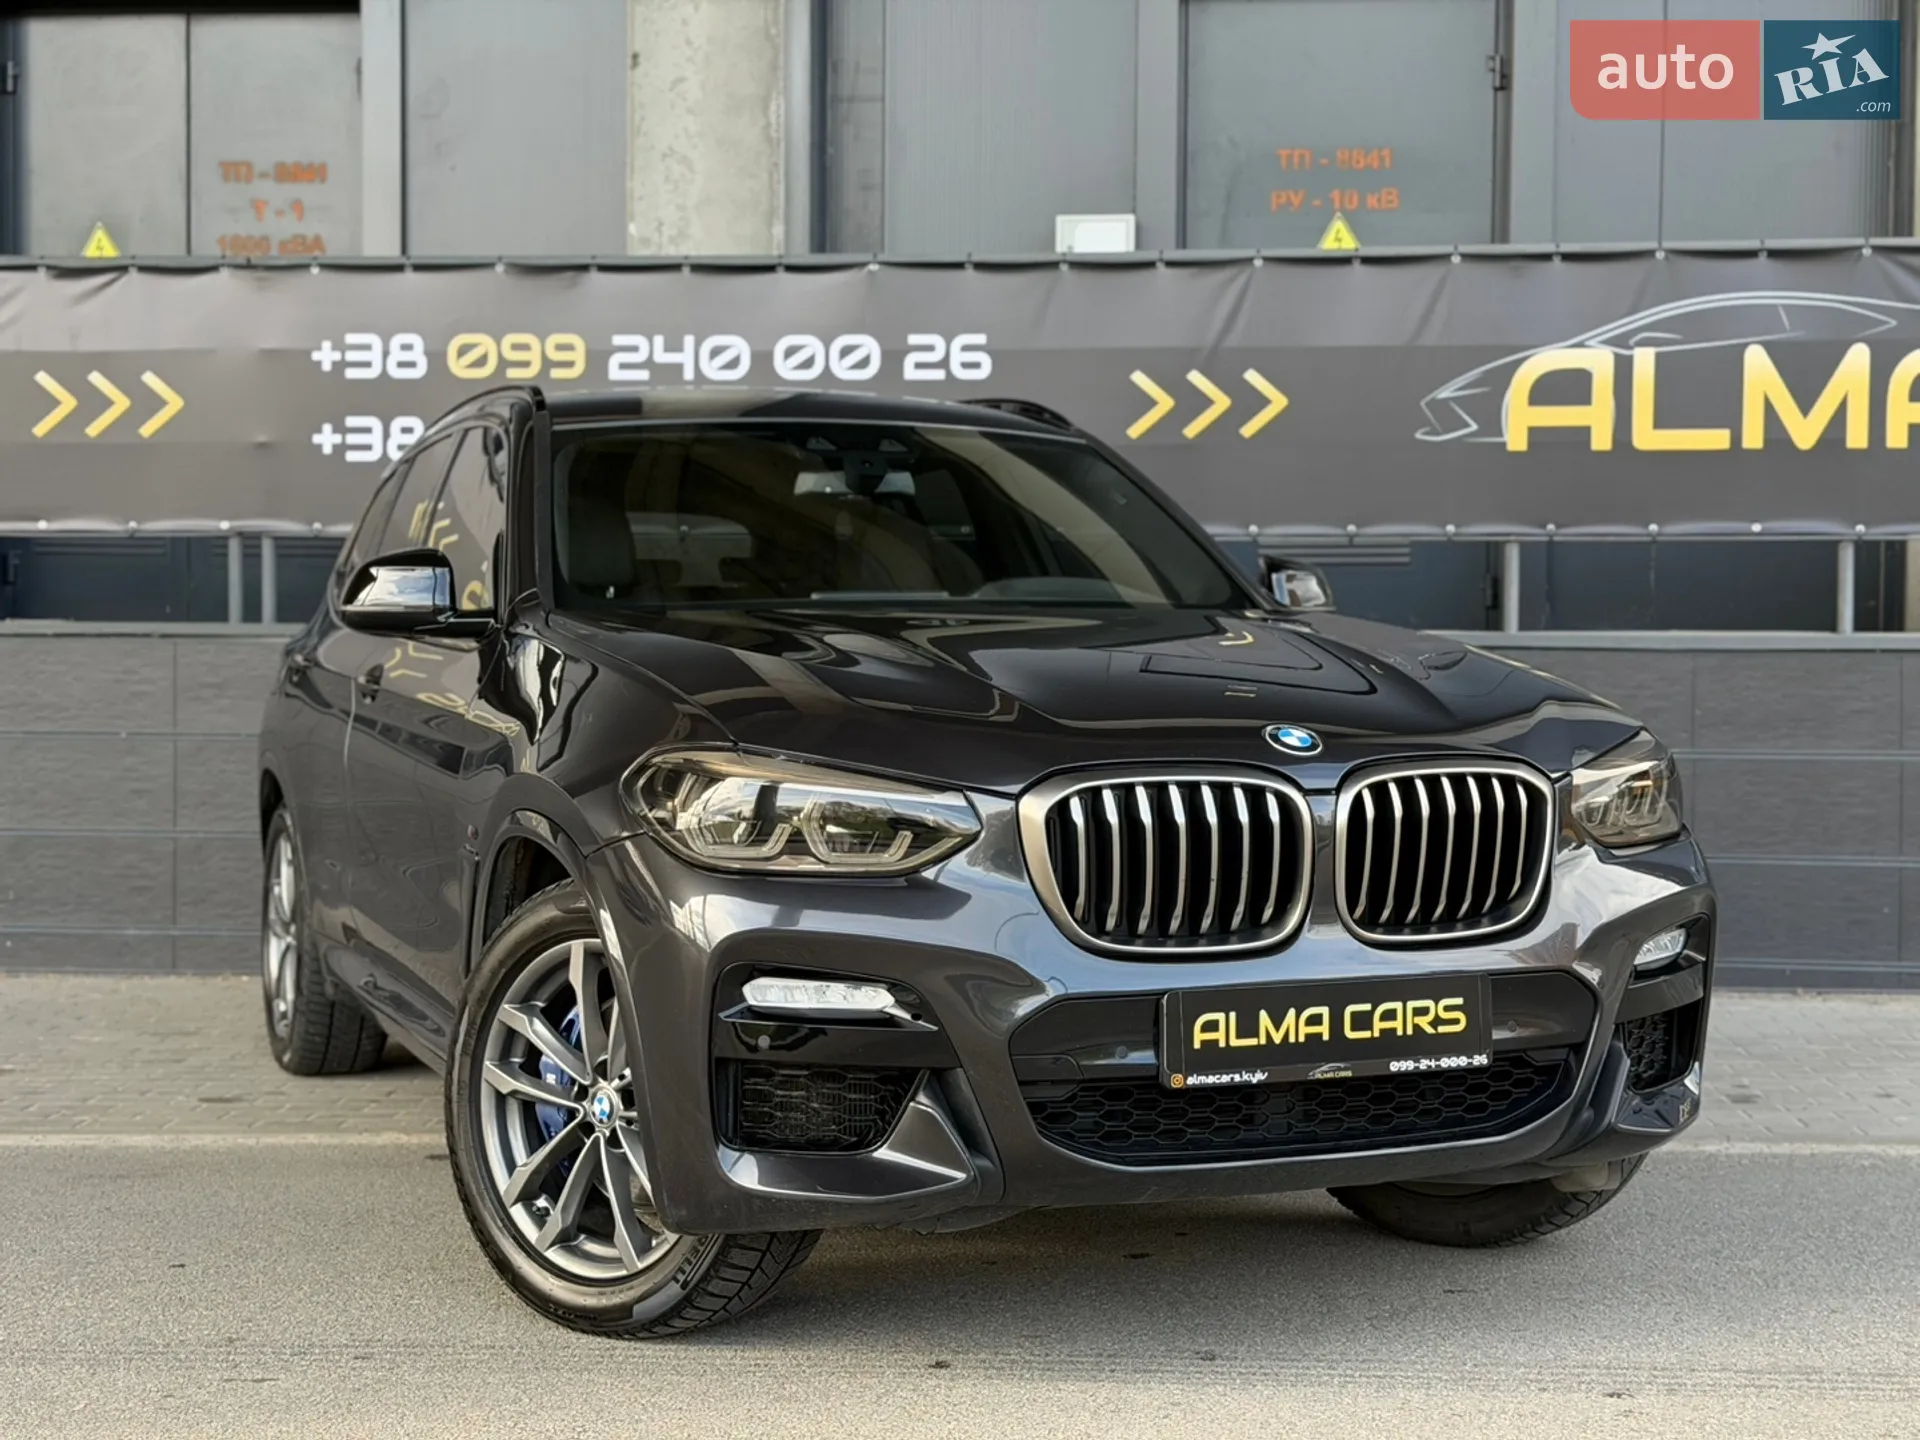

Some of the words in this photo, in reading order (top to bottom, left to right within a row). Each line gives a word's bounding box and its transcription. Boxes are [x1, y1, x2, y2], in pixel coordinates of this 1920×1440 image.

[311, 333, 428, 379] +38
[446, 333, 586, 379] 099
[608, 334, 751, 381] 240
[773, 334, 881, 380] 00
[903, 333, 993, 380] 26
[1193, 1006, 1330, 1049] ALMA
[1344, 997, 1467, 1039] CARS
[1389, 1054, 1489, 1072] 099-24-000-26
